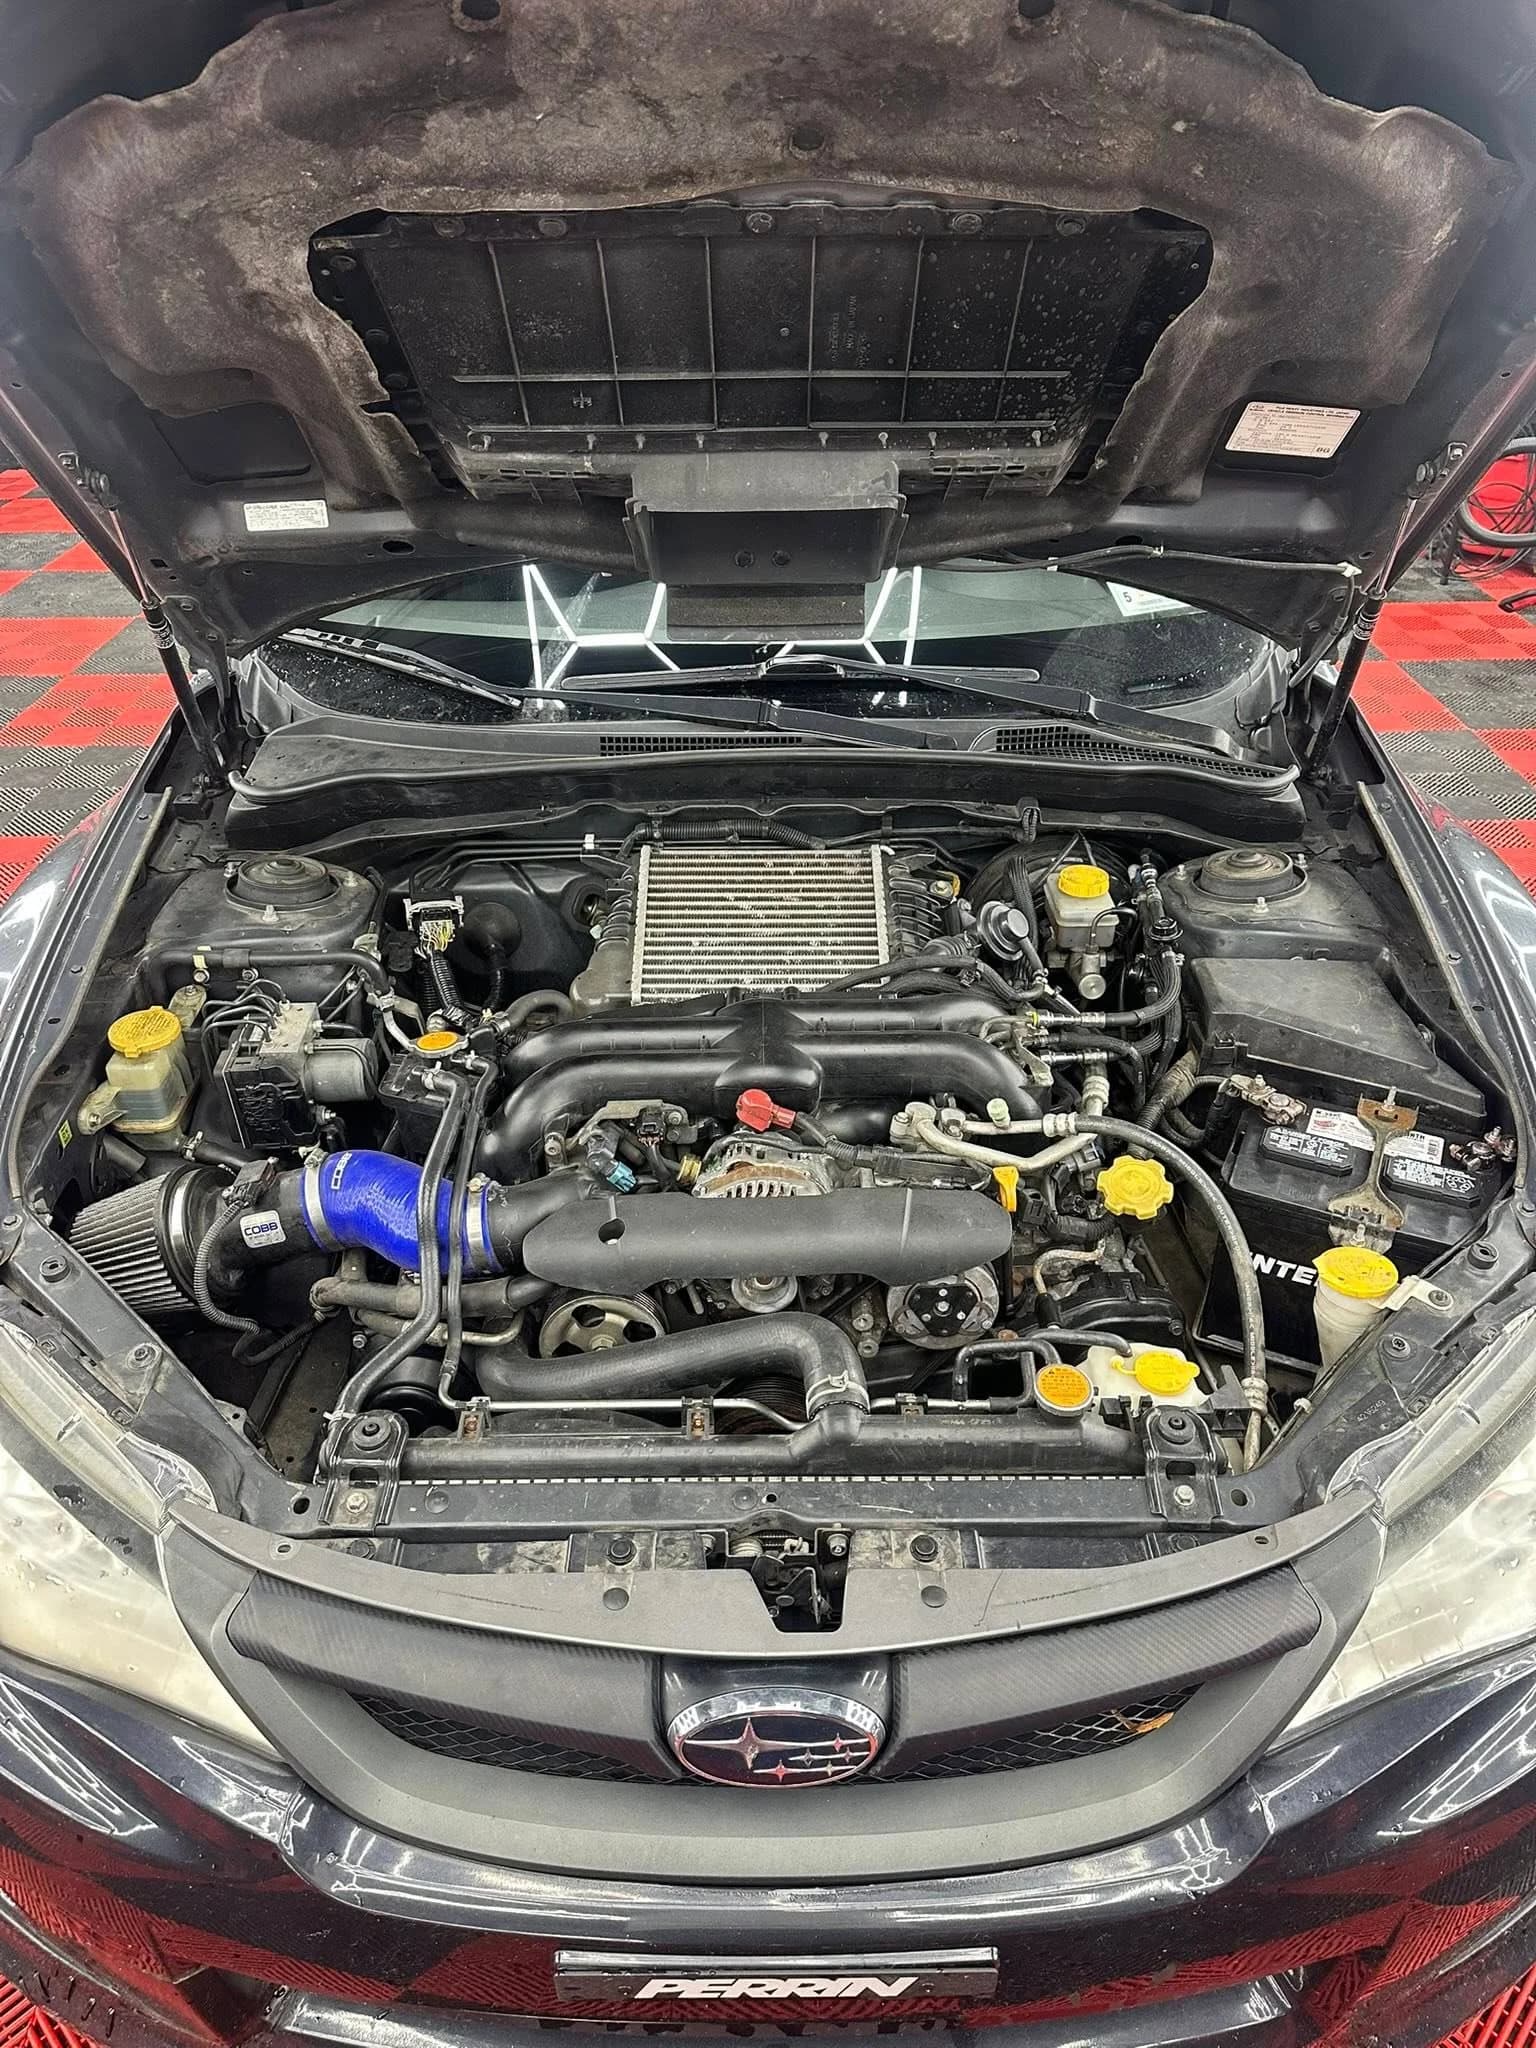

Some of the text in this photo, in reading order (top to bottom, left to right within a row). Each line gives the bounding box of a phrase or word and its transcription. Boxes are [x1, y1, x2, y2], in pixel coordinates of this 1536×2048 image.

[244, 1222, 278, 1236] COBB
[1251, 1252, 1318, 1287] NTE
[634, 1976, 919, 1999] PERRIN
